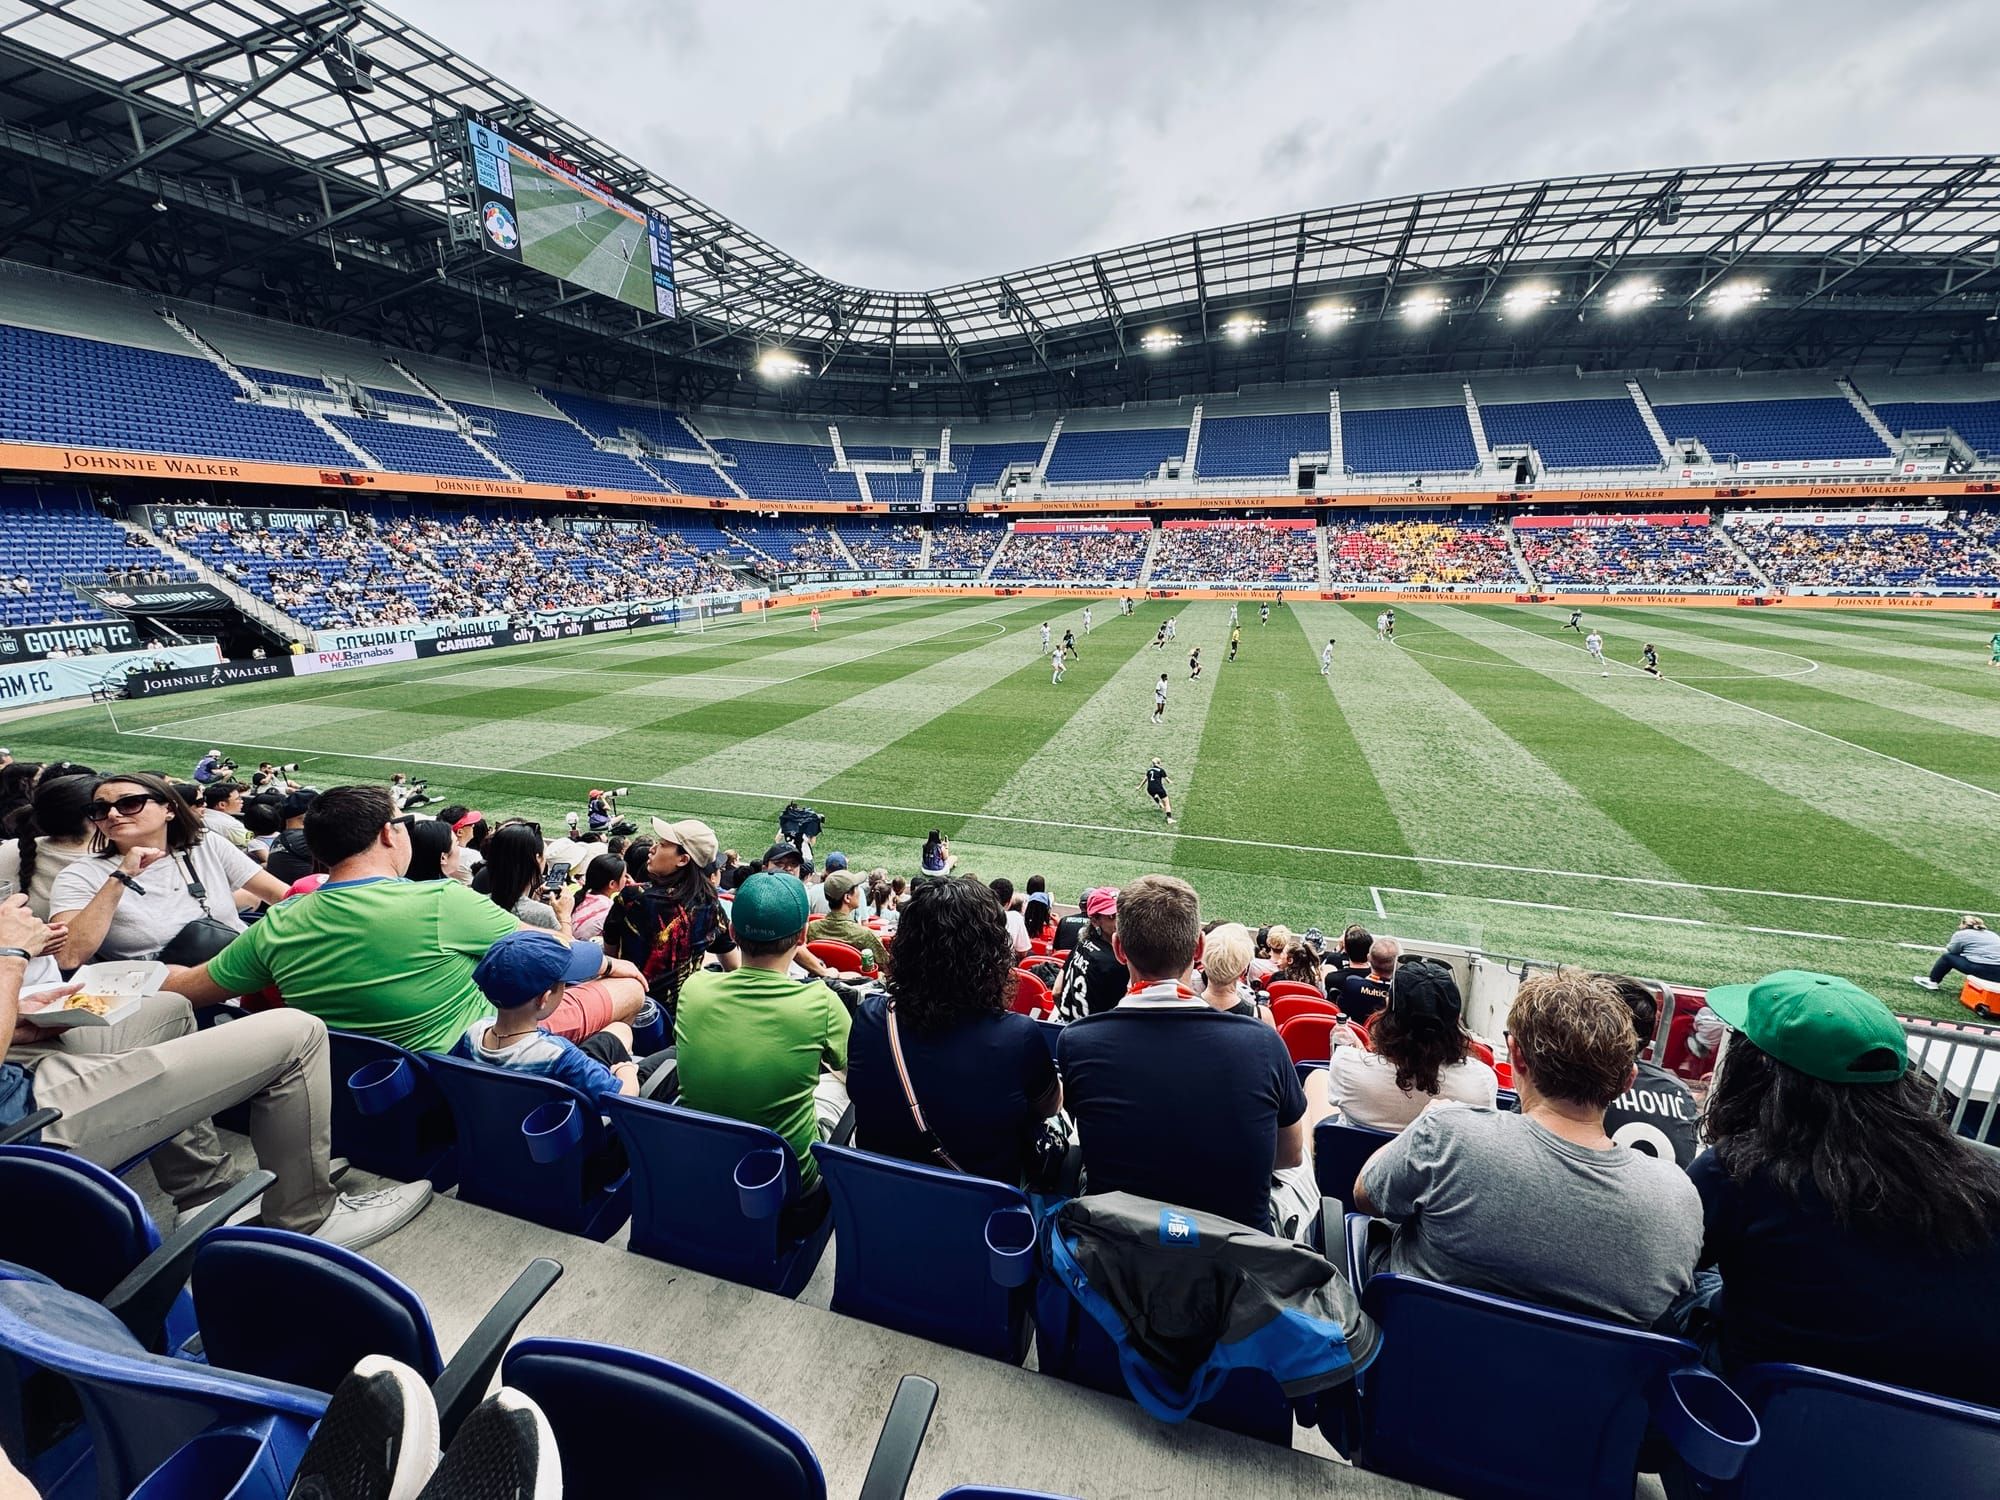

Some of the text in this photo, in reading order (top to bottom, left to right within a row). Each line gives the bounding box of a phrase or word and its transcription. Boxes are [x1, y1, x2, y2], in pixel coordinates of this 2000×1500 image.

[497, 140, 504, 154] 0
[649, 220, 655, 231] 0
[63, 452, 240, 476] JOHNNIE WALKER
[435, 479, 523, 494] JOHNNIE WALKER
[1808, 486, 1906, 496] JOHNNIE WALKER
[630, 494, 683, 504] JOHNNIE WALKER
[1377, 495, 1413, 504] JOHNNIE
[1579, 490, 1664, 500] JOHNNIE WALKER
[759, 502, 784, 510] JOHNNIE
[230, 513, 246, 528] FC
[1607, 518, 1624, 526] Red
[134, 591, 215, 604] GOTHAM FC
[1602, 595, 1687, 603] JOHNNIE WALKER
[1835, 598, 1933, 607] JOHNNIE WALKER
[436, 622, 486, 638] GOHAM
[564, 622, 584, 636] ally
[593, 619, 628, 631] NIKE SOCCER
[513, 628, 535, 643] ally
[540, 625, 560, 639] ally
[24, 626, 132, 653] GOTHAM FC
[336, 629, 416, 650] GOTHAM FC
[332, 659, 364, 669] HEALTH
[28, 671, 53, 693] FC
[143, 665, 279, 693] JOHNNIE WALKER
